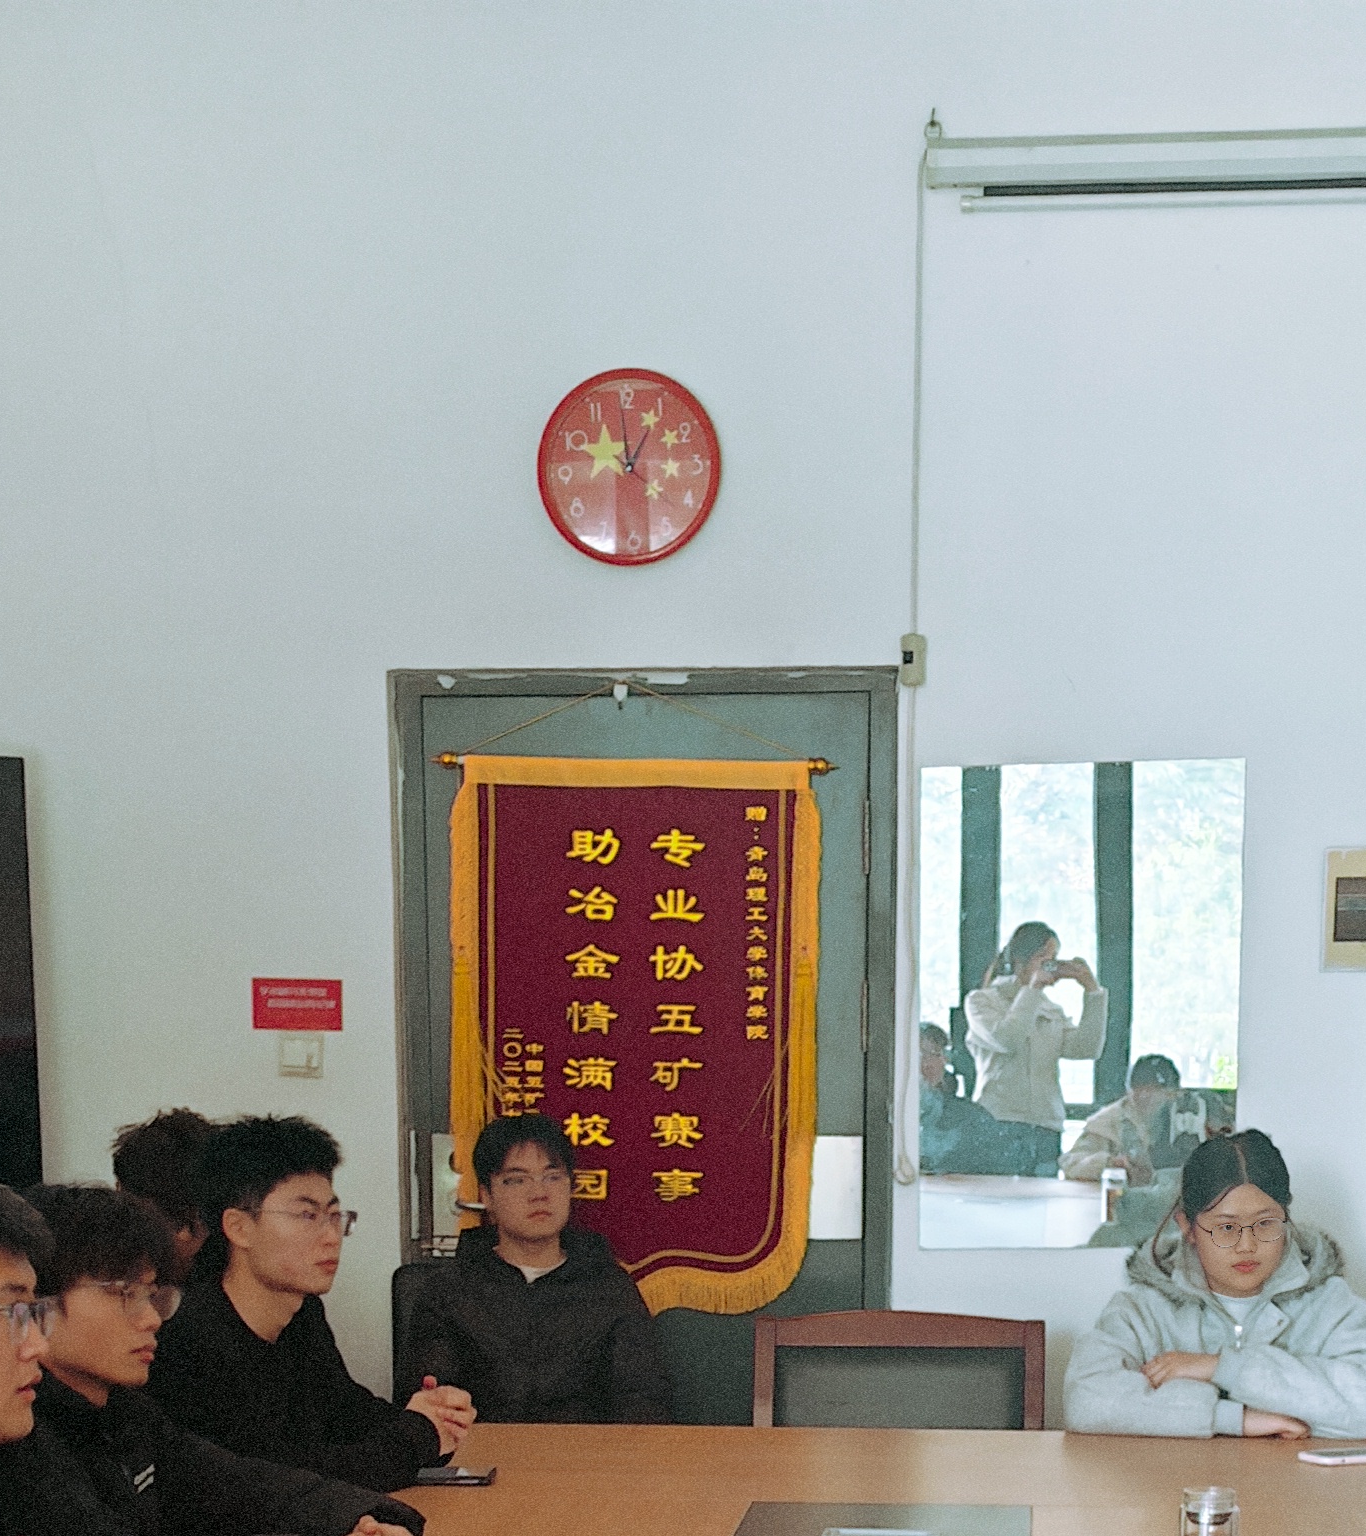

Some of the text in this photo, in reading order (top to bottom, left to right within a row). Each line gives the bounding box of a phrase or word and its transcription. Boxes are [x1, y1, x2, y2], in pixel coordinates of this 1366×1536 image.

[589, 402, 602, 423] 11
[657, 397, 663, 417] 1
[564, 429, 589, 452] 10
[678, 421, 691, 444] 2
[558, 465, 573, 485] 9
[691, 454, 704, 475] 3
[569, 497, 585, 518] 8
[682, 489, 694, 509] 4
[598, 521, 609, 543] 7
[661, 516, 673, 537] 5
[626, 531, 641, 552] 6
[563, 828, 621, 1201] 助冶金情满校园
[649, 828, 706, 1201] 专业协五矿赛事
